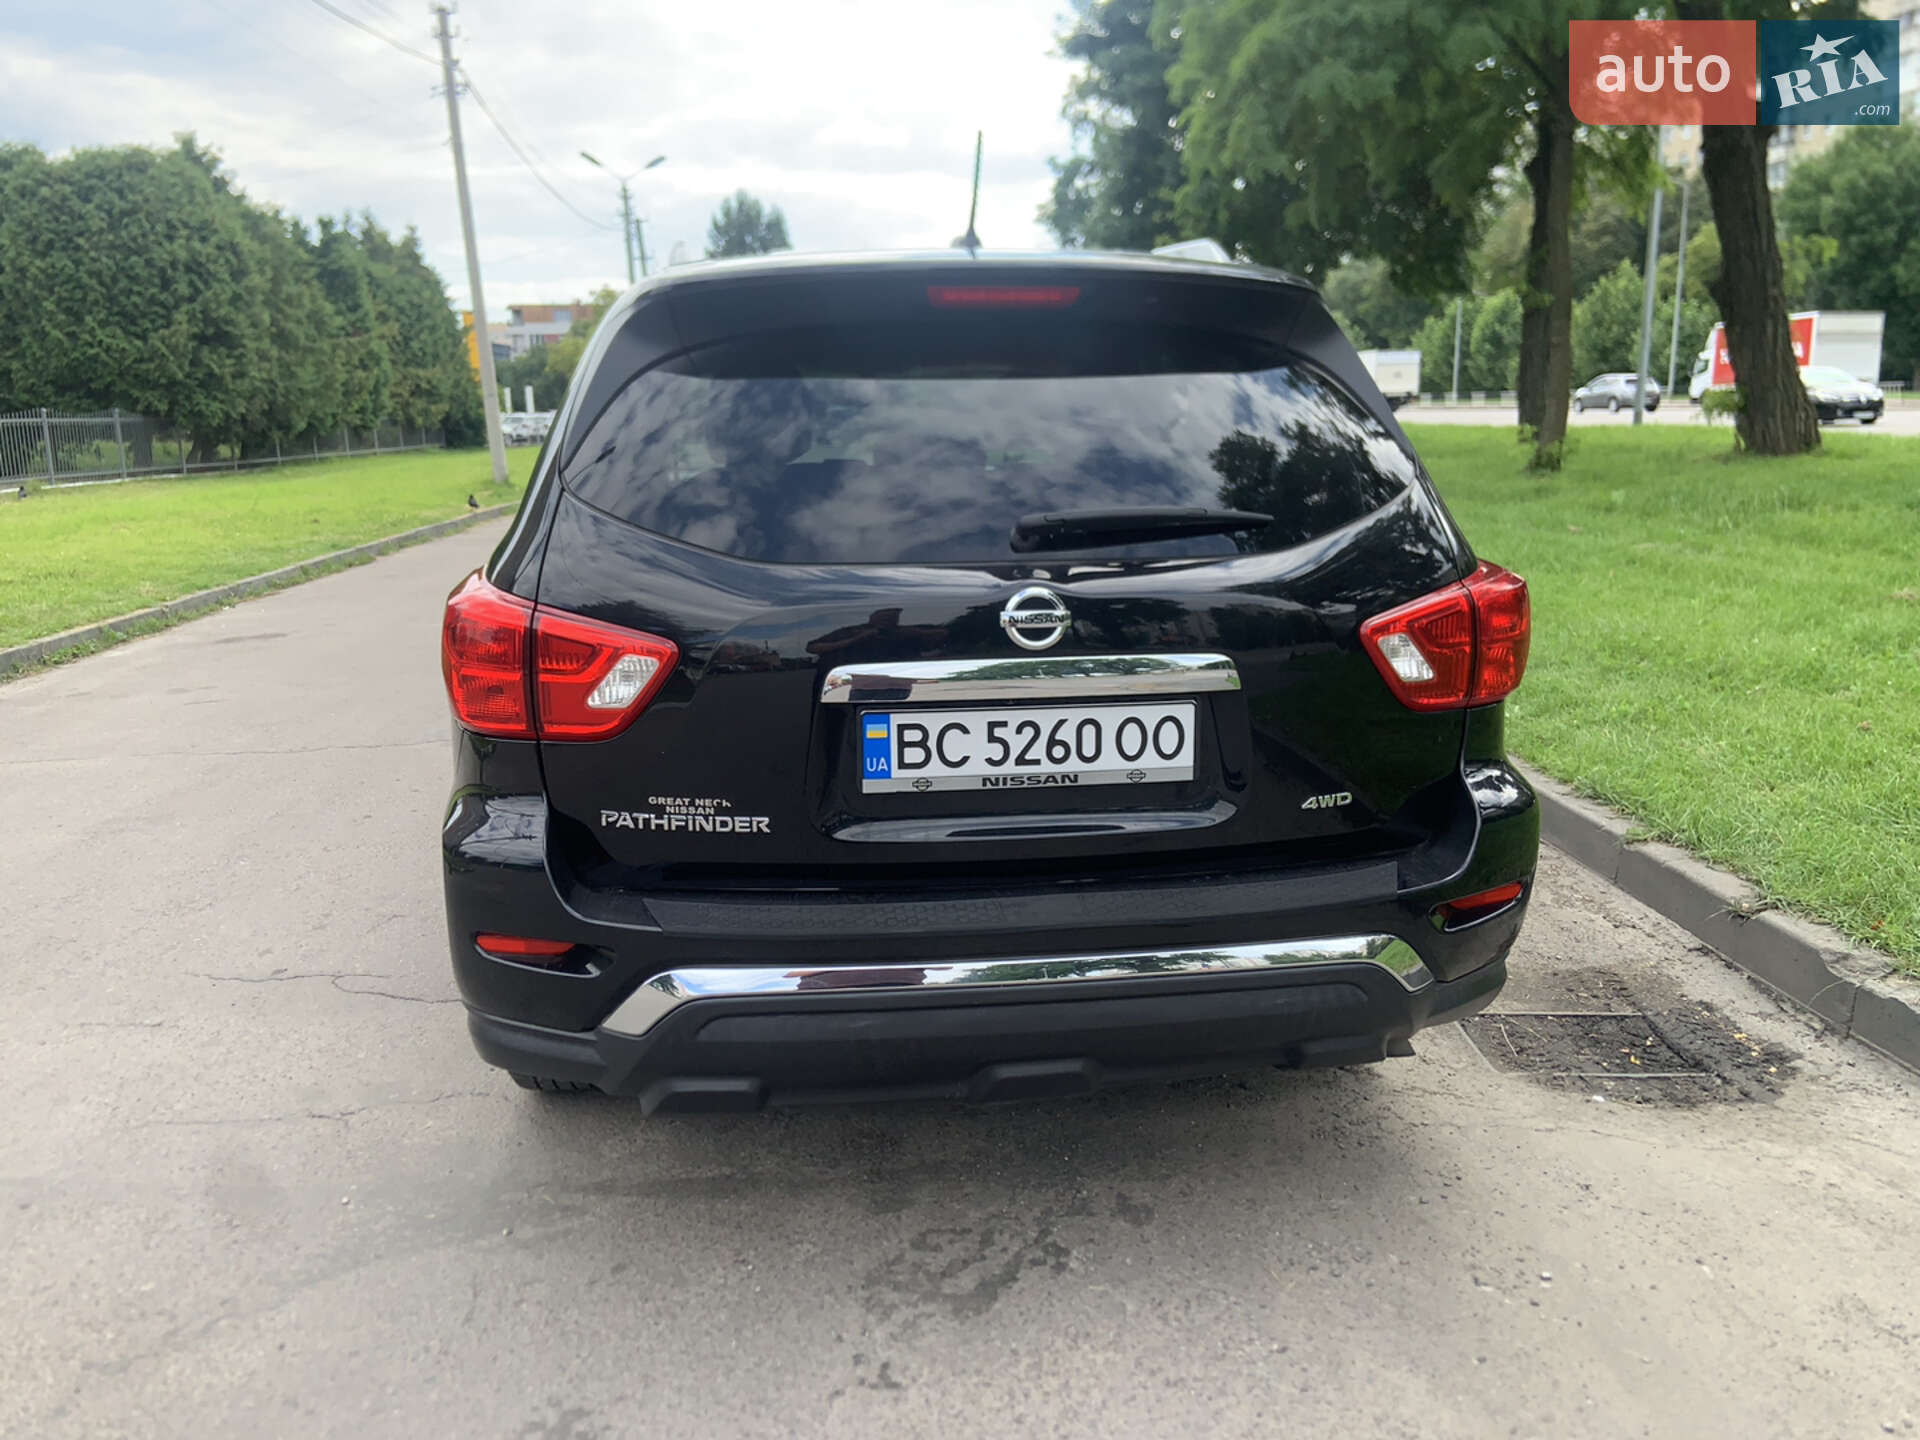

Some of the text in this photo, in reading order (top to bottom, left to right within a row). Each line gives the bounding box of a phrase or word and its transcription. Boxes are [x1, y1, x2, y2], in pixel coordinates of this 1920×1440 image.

[1008, 614, 1065, 624] NISSAN
[896, 715, 1185, 770] BC 5260 OO
[866, 757, 889, 773] UA
[981, 774, 1080, 788] NISSAN
[648, 796, 691, 806] GREAT
[1301, 792, 1353, 810] 4WD
[665, 806, 715, 815] NISSAN
[600, 809, 771, 833] PATHFINDER
